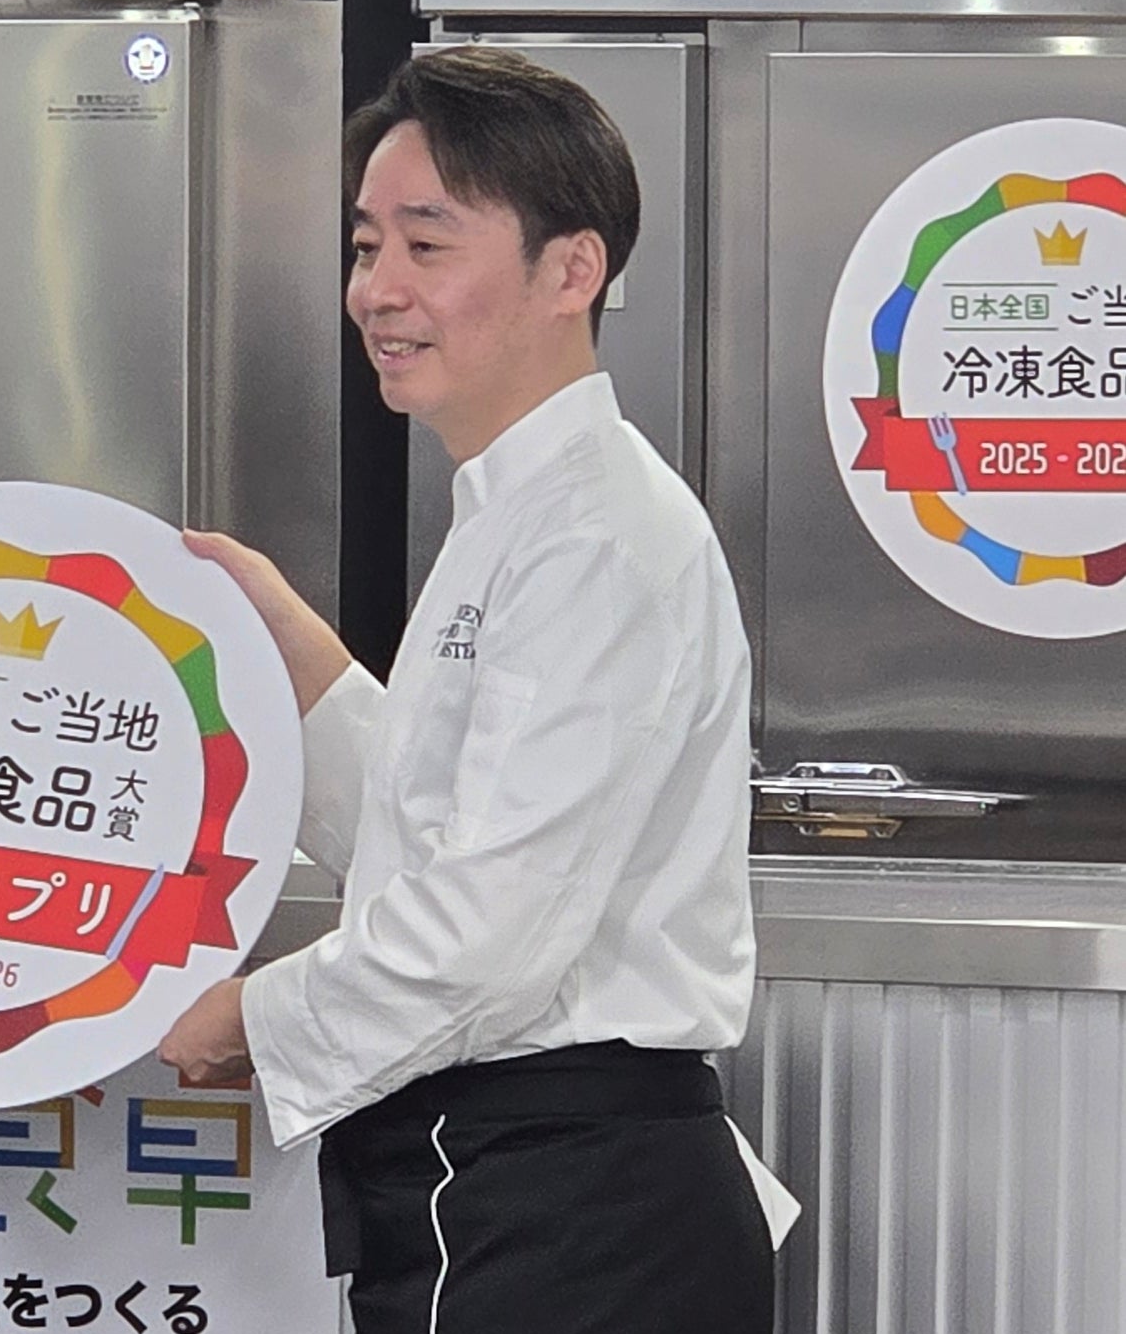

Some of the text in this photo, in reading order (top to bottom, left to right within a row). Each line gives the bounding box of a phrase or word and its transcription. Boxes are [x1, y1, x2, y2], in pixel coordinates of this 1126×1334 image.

[951, 293, 1050, 322] 日本全国
[980, 442, 1048, 475] 2025
[11, 686, 160, 753] ご当地
[102, 769, 148, 843] 大賞
